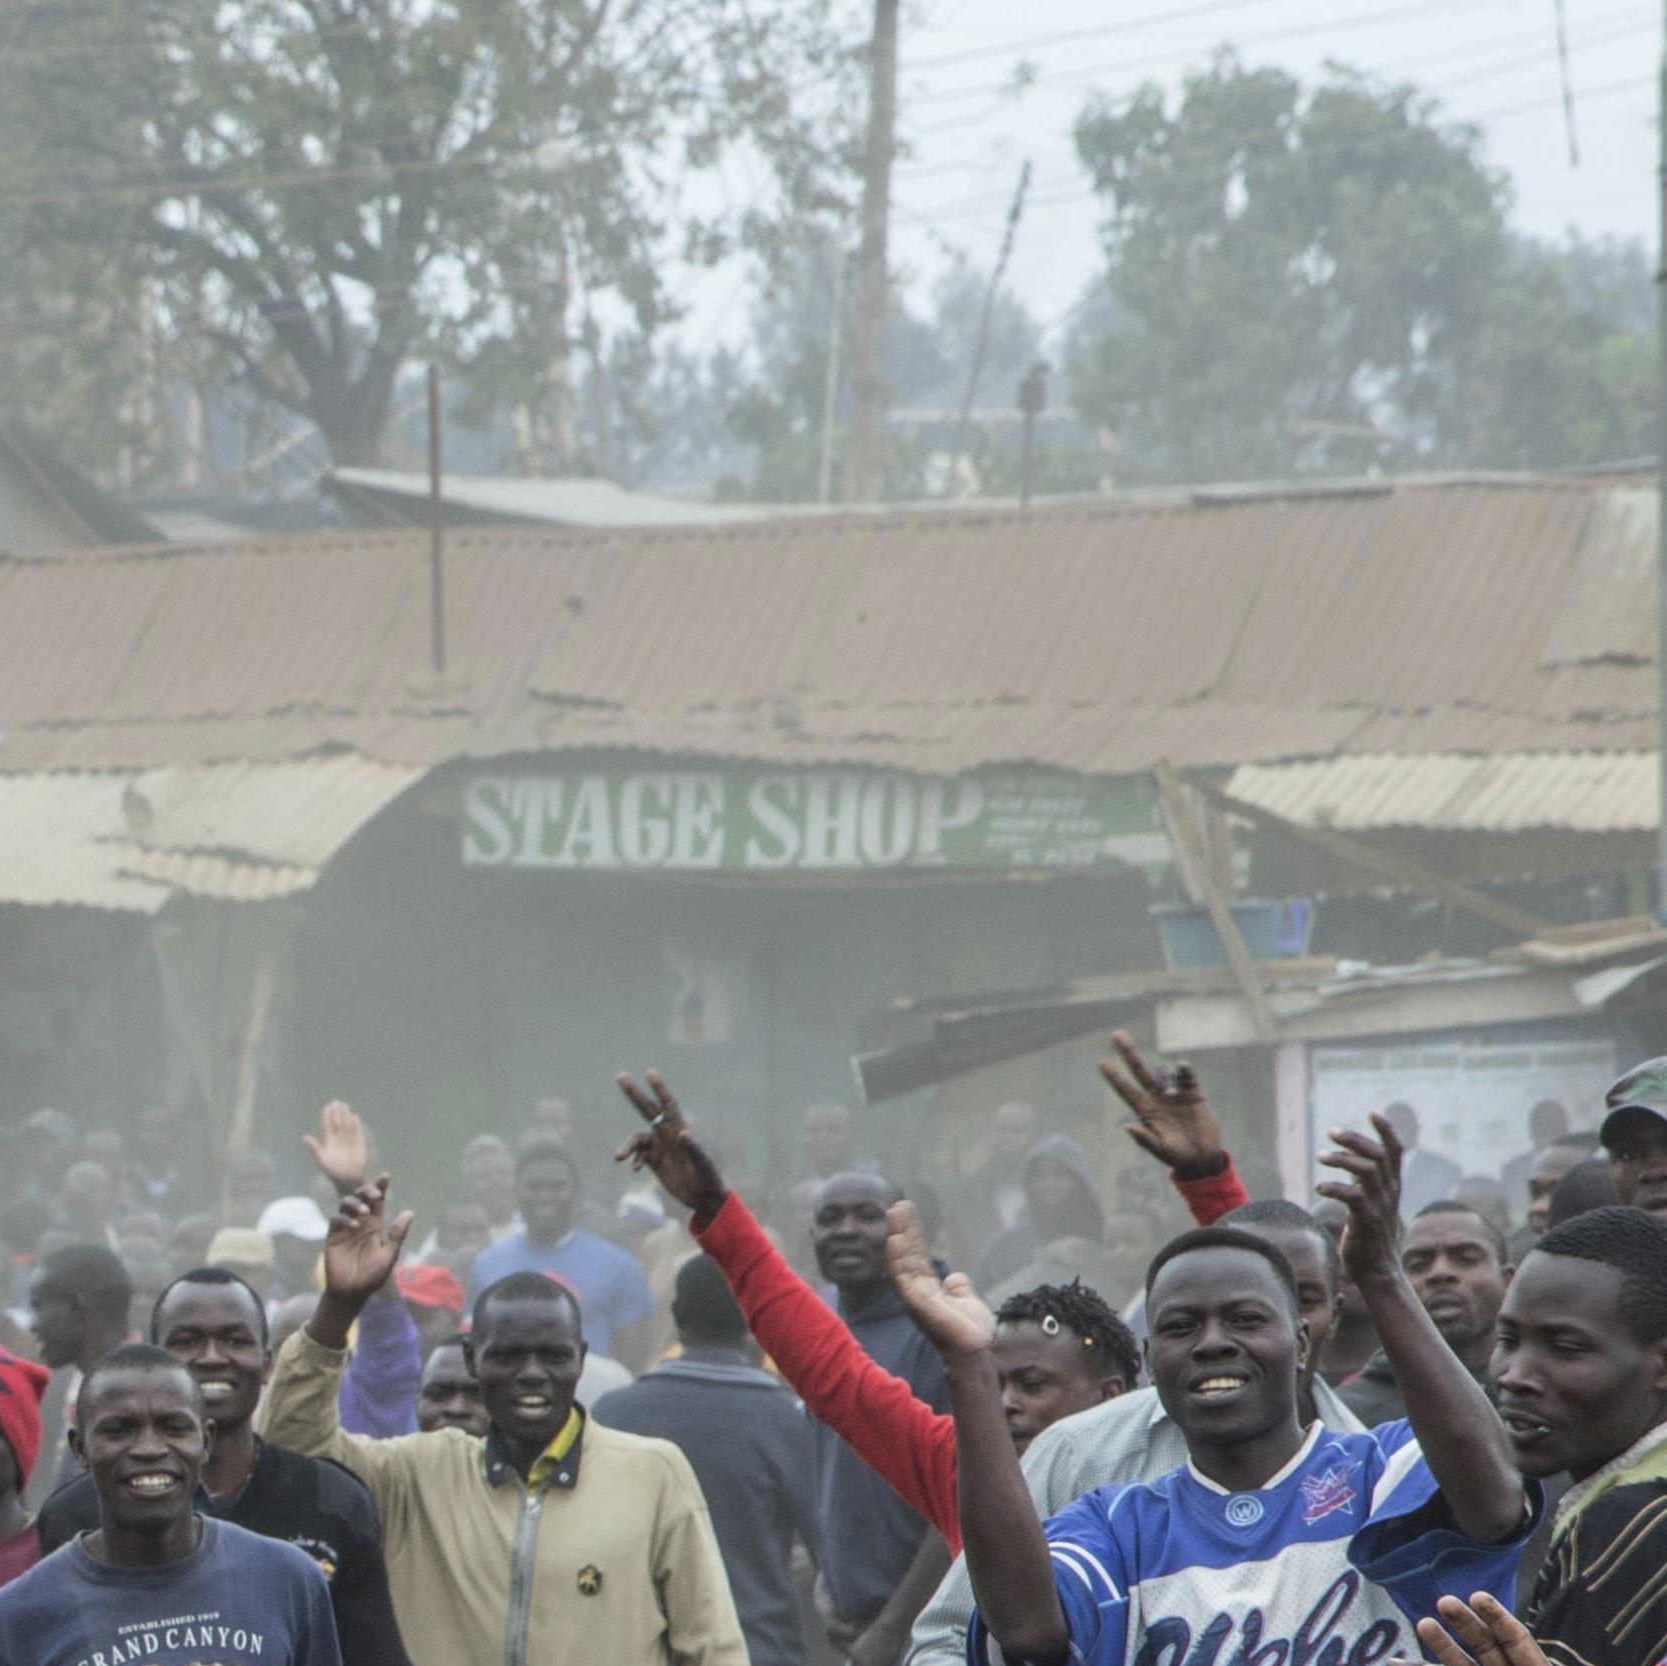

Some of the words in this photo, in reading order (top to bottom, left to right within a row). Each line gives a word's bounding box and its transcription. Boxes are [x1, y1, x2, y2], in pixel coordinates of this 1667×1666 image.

[462, 774, 724, 869] STAGE
[746, 772, 983, 869] SHOP
[118, 1614, 196, 1635] ESTABLISHED
[166, 1626, 264, 1656] CANYON
